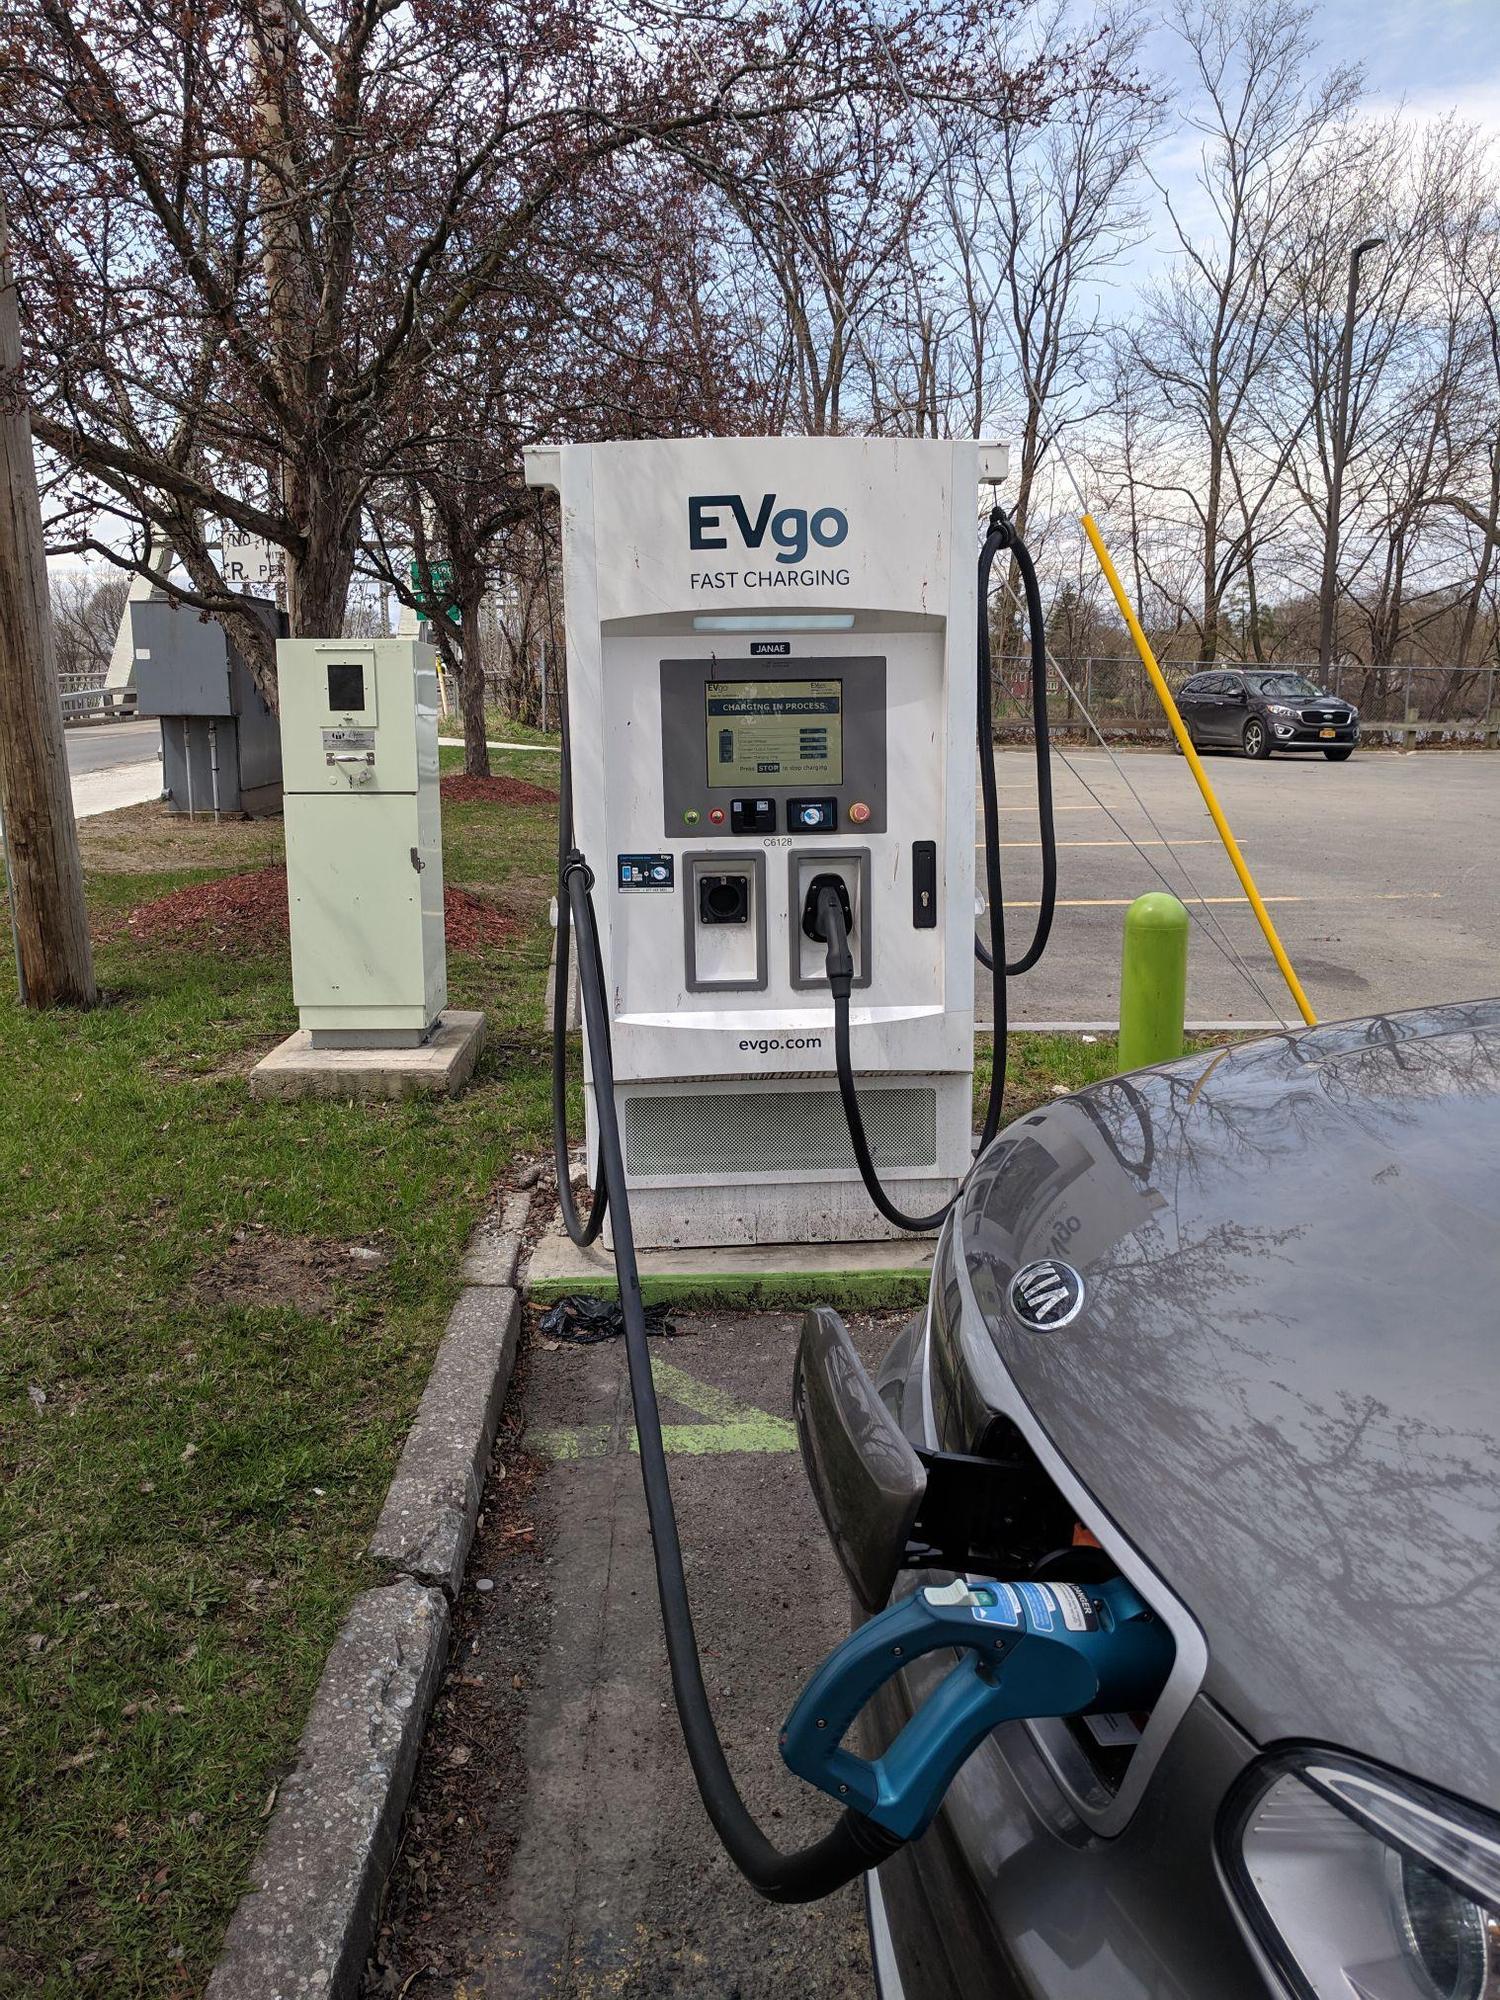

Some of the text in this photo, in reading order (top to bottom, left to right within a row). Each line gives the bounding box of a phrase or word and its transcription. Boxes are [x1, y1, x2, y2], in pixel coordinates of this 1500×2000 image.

[688, 494, 849, 564] EVgo
[229, 533, 251, 547] NO
[690, 569, 850, 590] FAST CHARGING
[756, 644, 786, 653] JANAE
[722, 701, 825, 711] CHARGING IN PROCESS
[758, 764, 779, 772] STOP
[763, 838, 793, 847] C6128
[738, 1037, 822, 1054] evgo.com
[1016, 1261, 1070, 1321] KIA
[1073, 1585, 1092, 1614] DANGER
